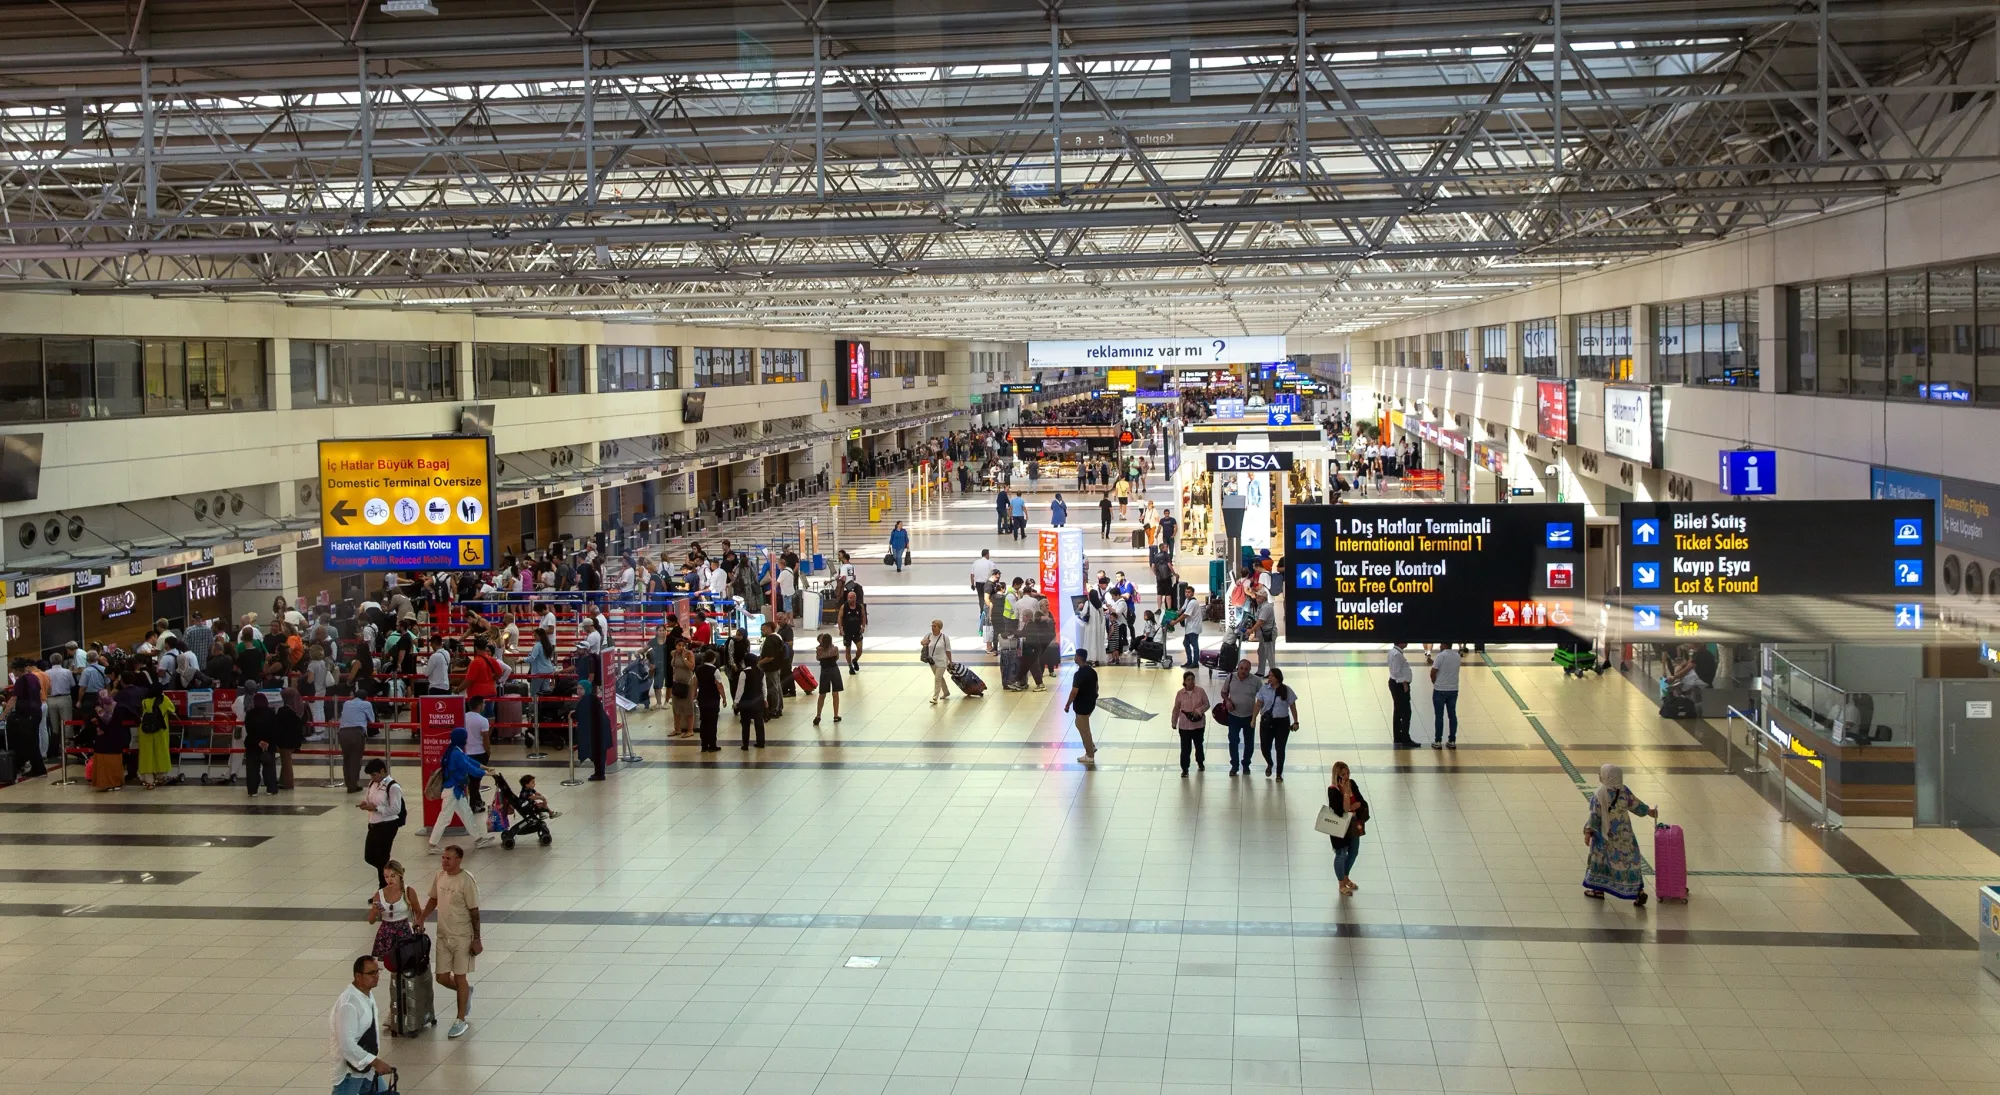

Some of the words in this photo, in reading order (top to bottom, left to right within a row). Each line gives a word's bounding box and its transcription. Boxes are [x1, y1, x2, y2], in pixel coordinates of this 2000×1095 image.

[1087, 345, 1154, 359] reklamınız
[1158, 347, 1181, 358] var
[1185, 345, 1202, 357] mı
[1212, 339, 1226, 361] ?
[327, 459, 337, 472] İç
[341, 460, 374, 471] Hatlar
[378, 459, 414, 472] Büyük
[417, 458, 450, 471] Bagaj
[1217, 454, 1281, 470] DESA
[328, 478, 380, 488] Domestic
[383, 477, 430, 488] Terminal
[433, 476, 482, 487] Oversize
[1335, 519, 1348, 534] 1.
[1352, 518, 1374, 538] Dış
[1377, 518, 1422, 534] Hatlar
[1425, 517, 1492, 534] Terminali
[1673, 514, 1708, 529] Bilet
[1711, 512, 1746, 533] Satış
[331, 541, 362, 551] Hareket
[364, 540, 401, 552] Kabiliyeti
[403, 540, 427, 550] Kısıtlı
[428, 540, 451, 550] Yolcu
[1335, 535, 1414, 552] International
[1418, 535, 1473, 551] Terminal
[1477, 536, 1482, 551] 1
[1675, 534, 1712, 551] Ticket
[1715, 532, 1749, 550] Sales
[203, 548, 213, 560] 304
[331, 556, 369, 567] Passenger
[371, 556, 387, 564] With
[389, 556, 422, 564] Reduced
[423, 555, 453, 566] Mobility
[130, 560, 142, 575] 303
[1335, 560, 1358, 576] Tax
[1361, 560, 1391, 576] Free
[1395, 559, 1446, 576] Kontrol
[1673, 557, 1714, 576] Kayıp
[1717, 557, 1751, 577] Eşya
[75, 570, 89, 585] 302
[1335, 578, 1356, 593] Tax
[1359, 578, 1386, 593] Free
[1389, 577, 1434, 593] Control
[1674, 577, 1701, 593] Lost
[1703, 577, 1714, 593] &
[1717, 576, 1759, 593] Found
[15, 579, 30, 596] 301
[1335, 598, 1404, 613] Tuvaletler
[1673, 600, 1709, 620] Çıkış
[1336, 614, 1375, 631] Toilets
[1675, 621, 1699, 637] Exit
[423, 737, 439, 745] BÜYÜK
